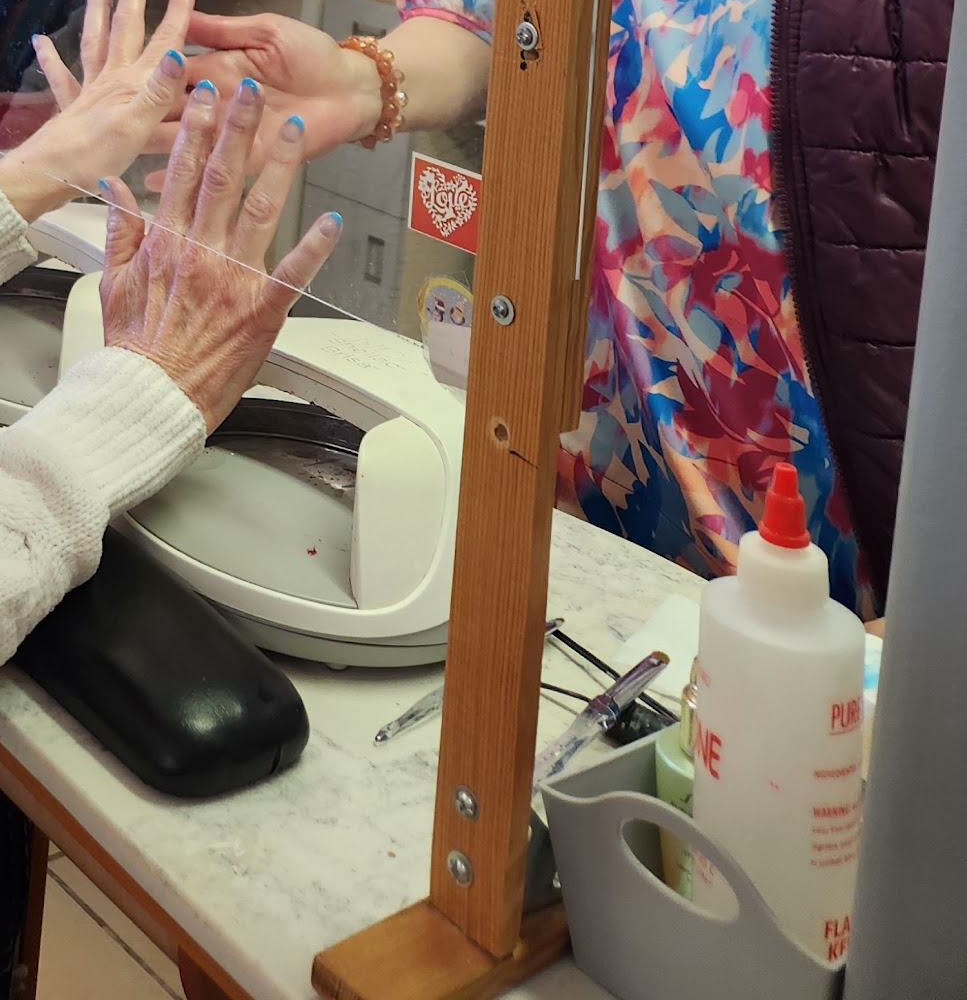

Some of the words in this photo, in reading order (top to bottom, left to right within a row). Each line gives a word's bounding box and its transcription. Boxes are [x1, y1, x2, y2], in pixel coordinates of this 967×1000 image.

[429, 178, 470, 214] Love
[695, 712, 722, 780] NE
[824, 916, 851, 939] FLA
